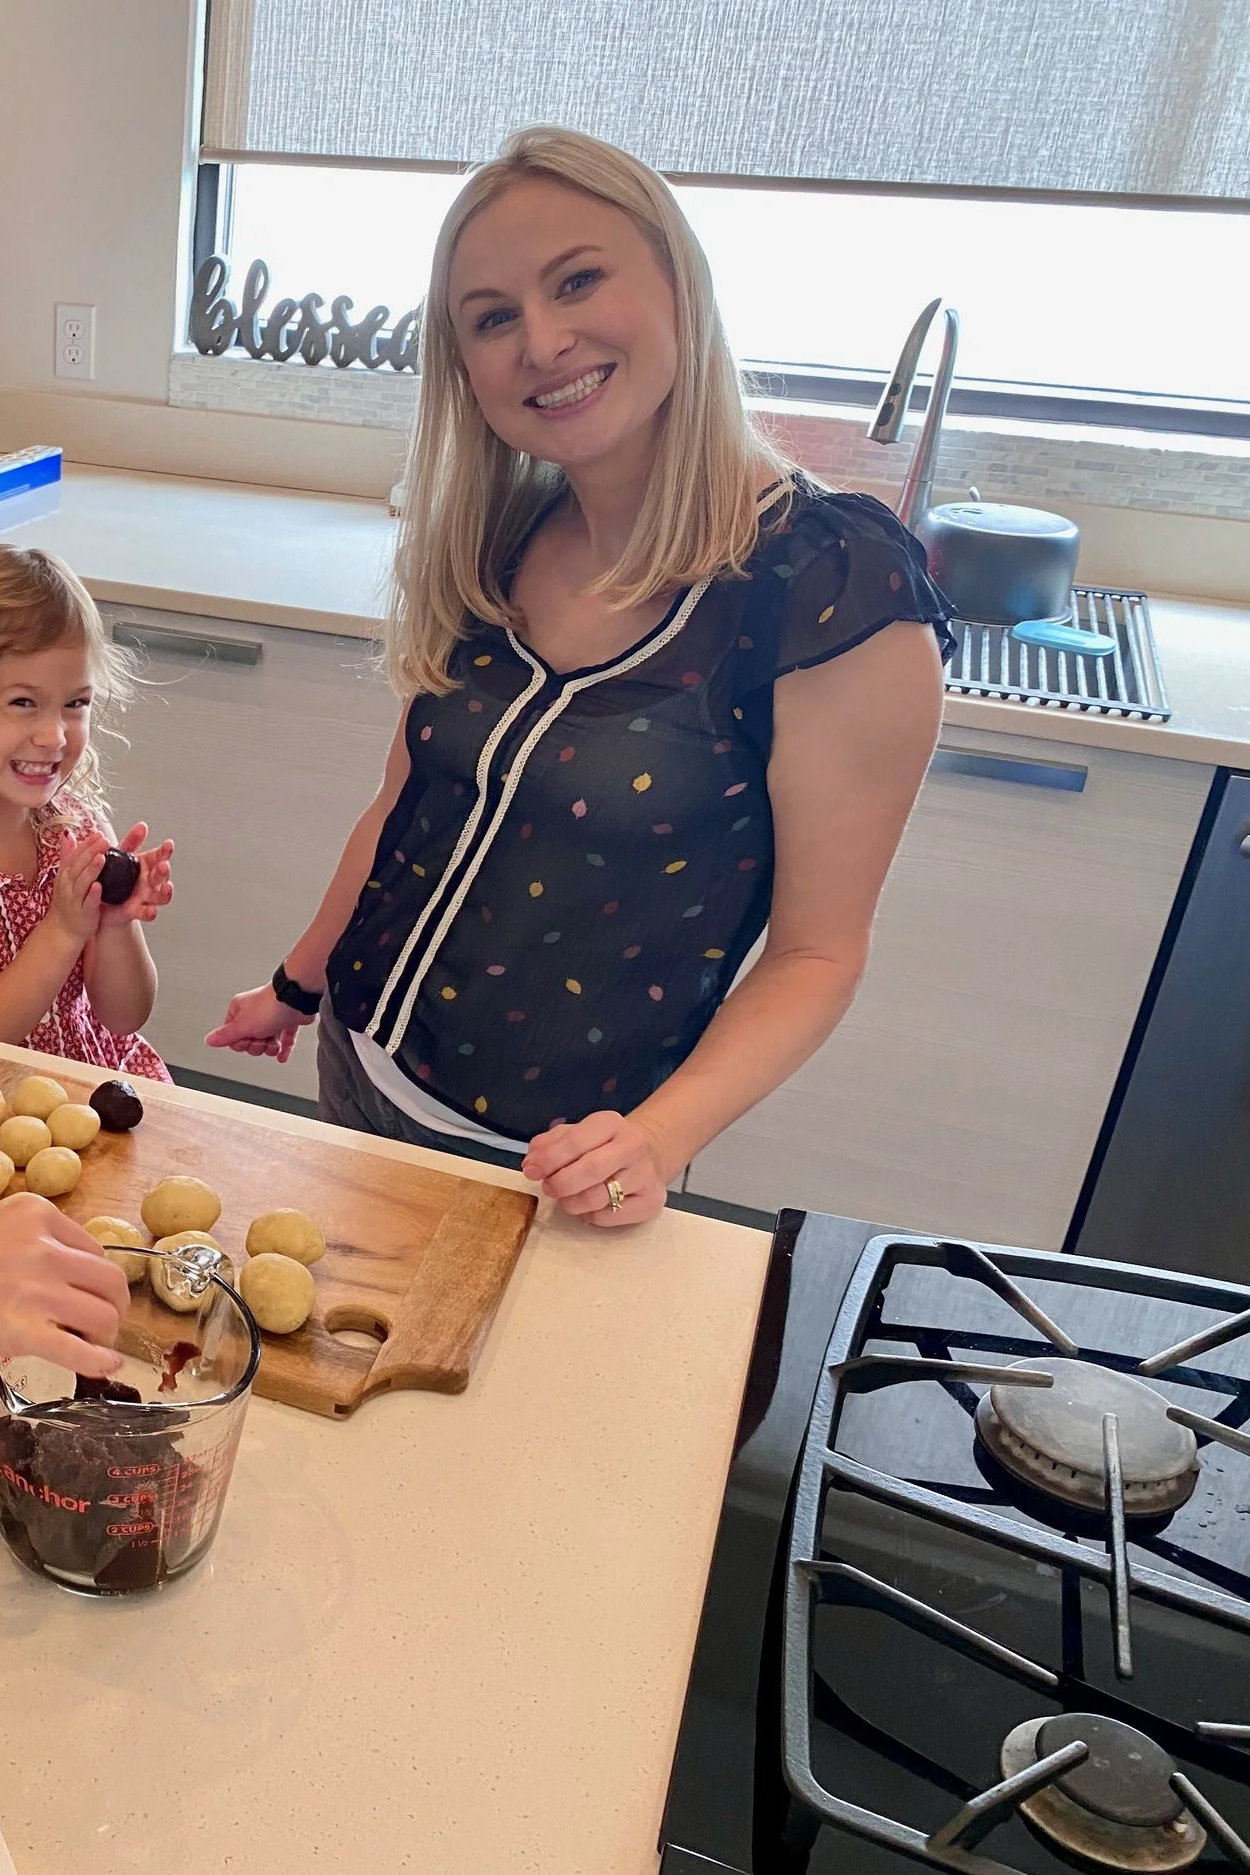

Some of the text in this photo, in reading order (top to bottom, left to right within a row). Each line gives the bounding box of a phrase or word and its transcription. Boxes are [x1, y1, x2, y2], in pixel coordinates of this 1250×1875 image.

[112, 1465, 157, 1476] 4 CUPS
[110, 1493, 155, 1505] 3 CUPS
[111, 1523, 151, 1534] 2 CUPS
